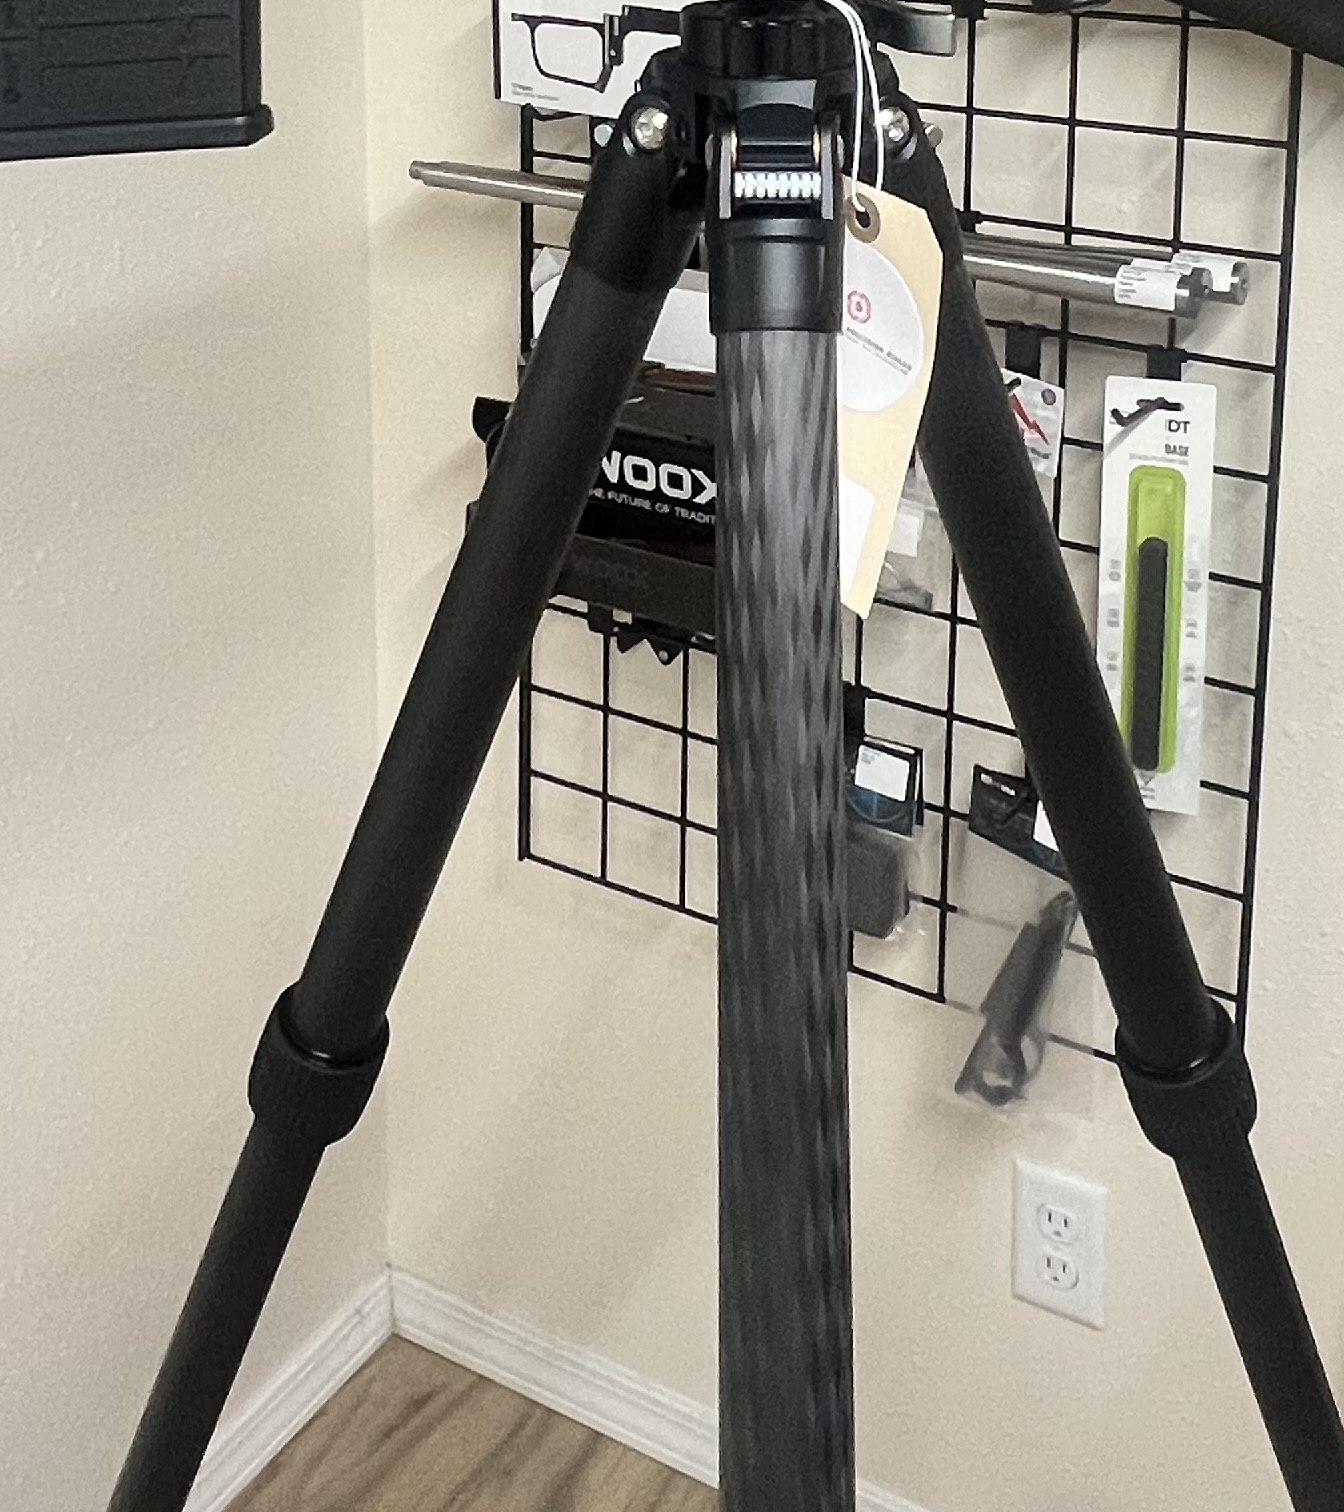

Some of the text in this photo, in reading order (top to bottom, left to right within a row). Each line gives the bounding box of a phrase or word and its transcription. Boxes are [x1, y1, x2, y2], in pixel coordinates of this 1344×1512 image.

[1165, 419, 1191, 434] DT
[607, 490, 652, 511] FUTURE
[674, 506, 716, 525] TRADIT
